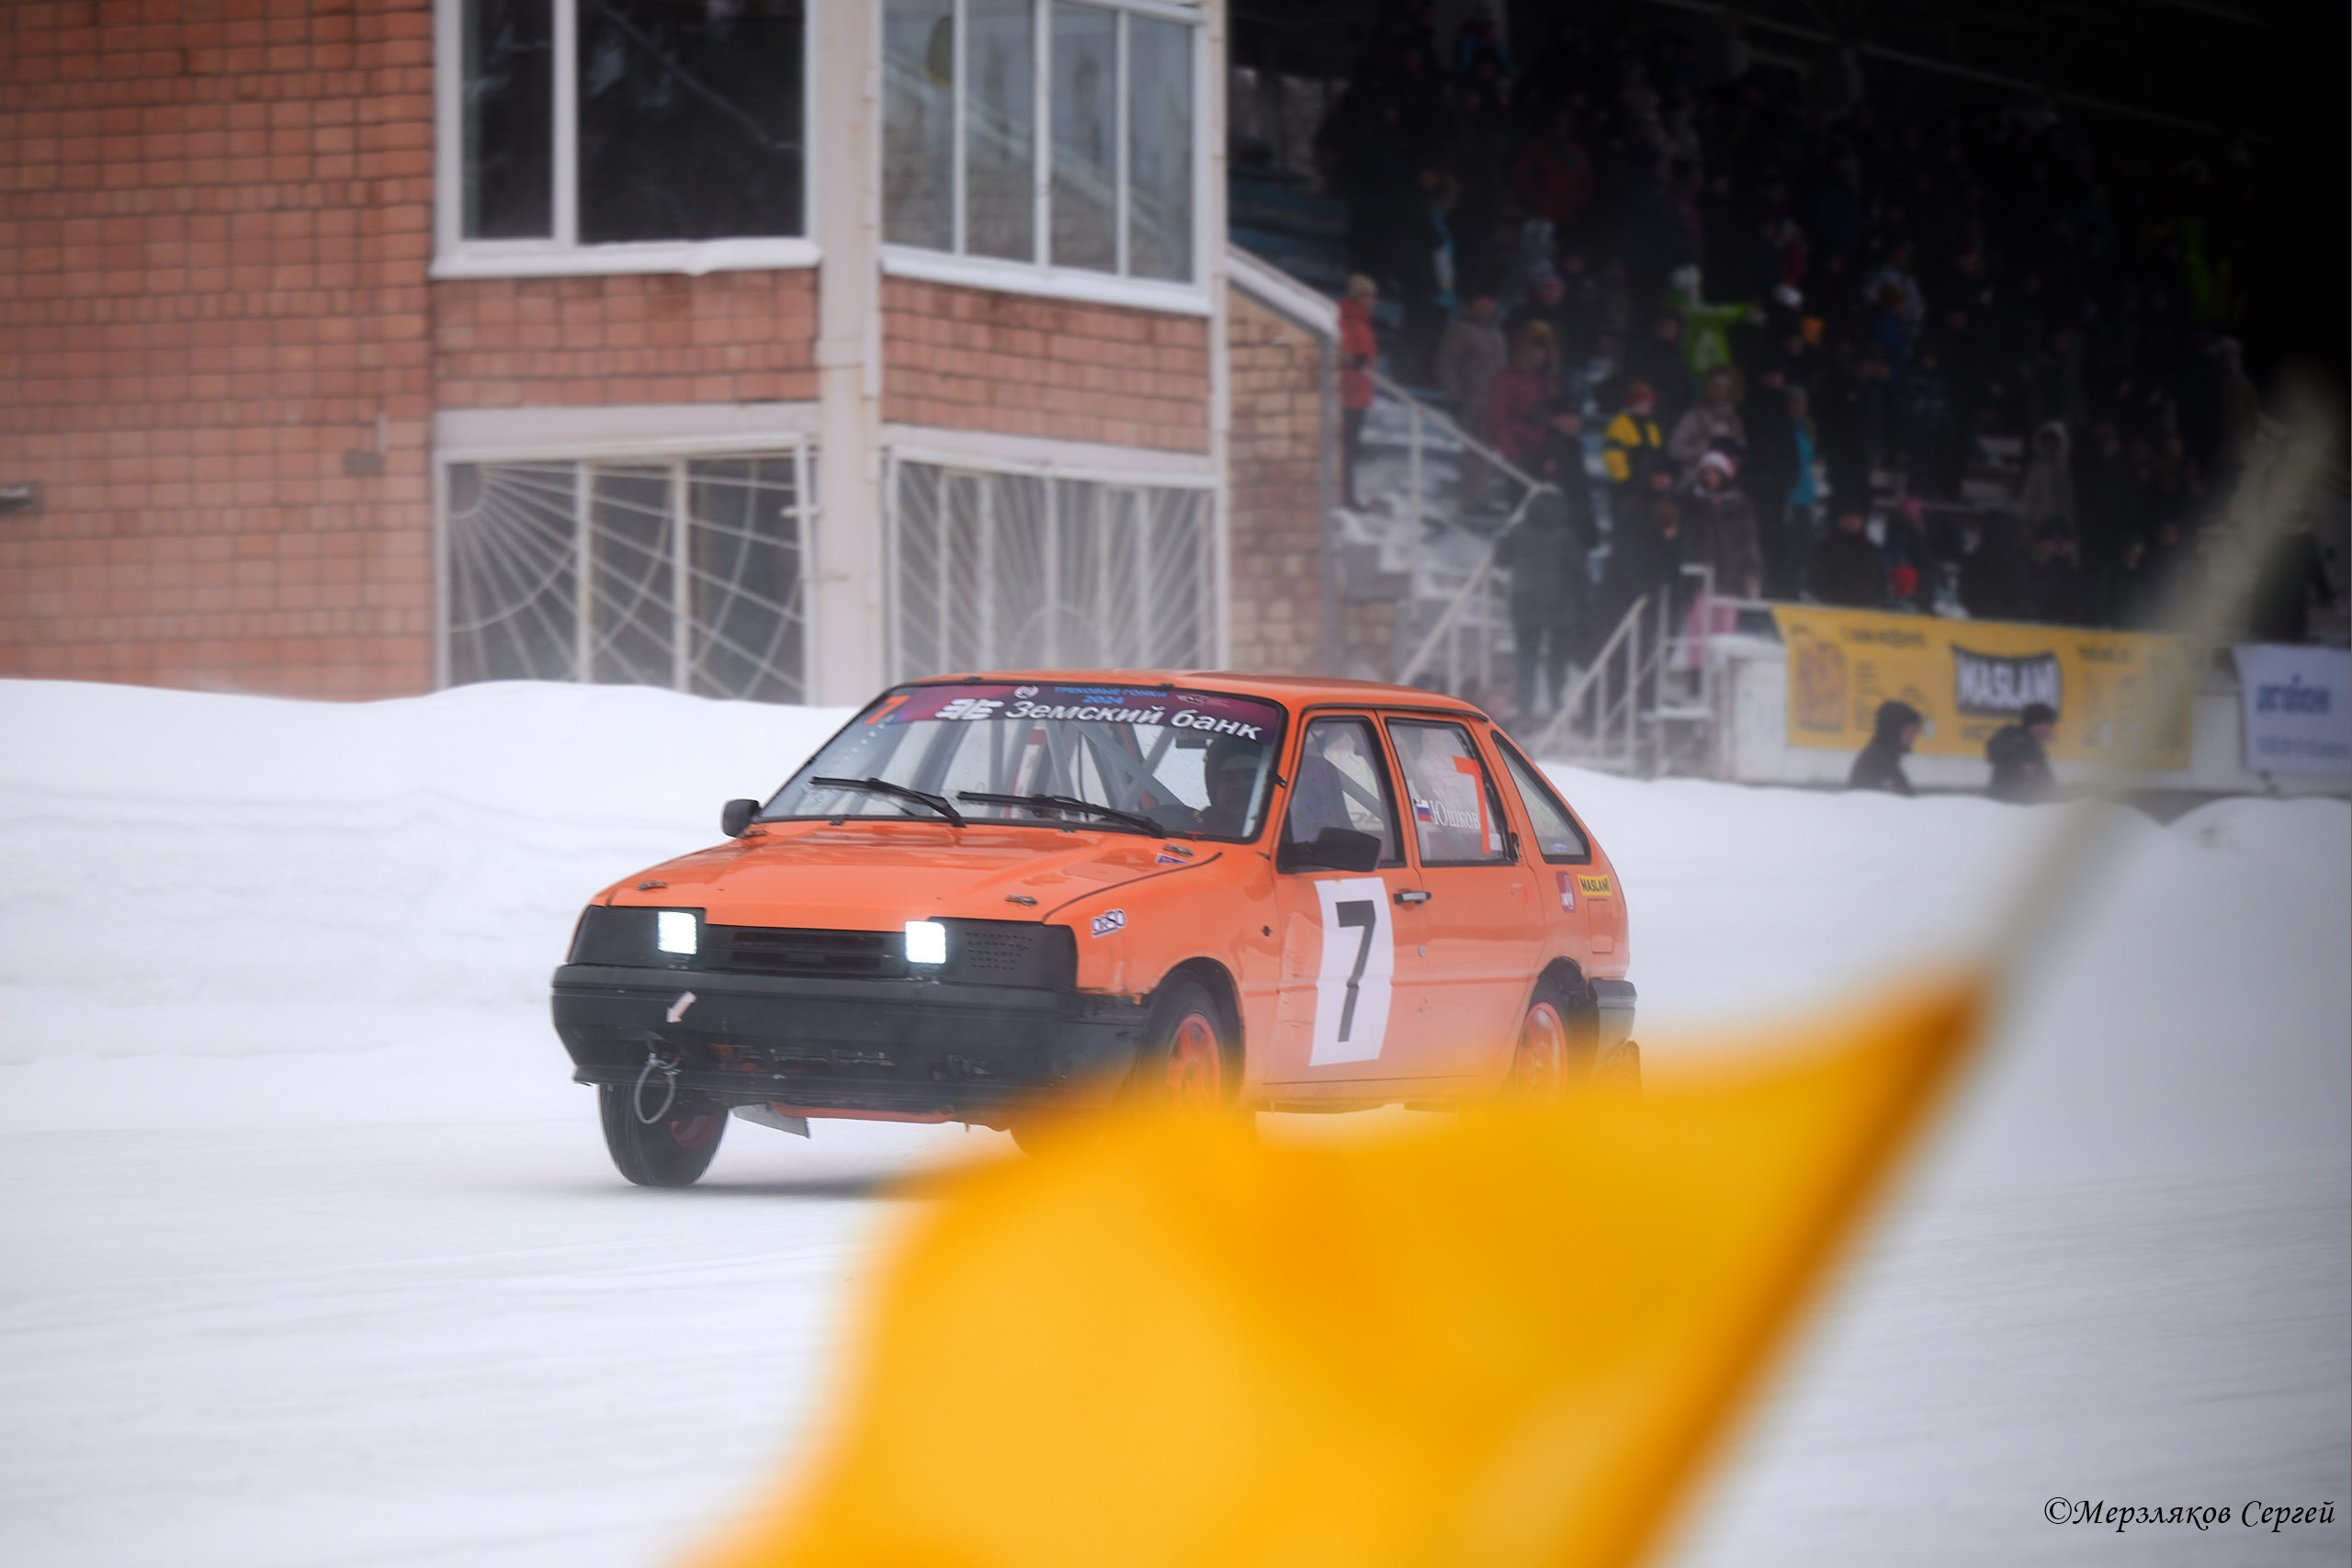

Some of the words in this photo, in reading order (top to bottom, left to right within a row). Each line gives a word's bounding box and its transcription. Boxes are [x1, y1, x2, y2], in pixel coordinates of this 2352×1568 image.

[1081, 695, 1125, 705] 2024
[1005, 700, 1165, 725] Земский
[1170, 708, 1263, 741] банк
[1429, 800, 1480, 829] Юшков
[1335, 900, 1376, 1043] 7
